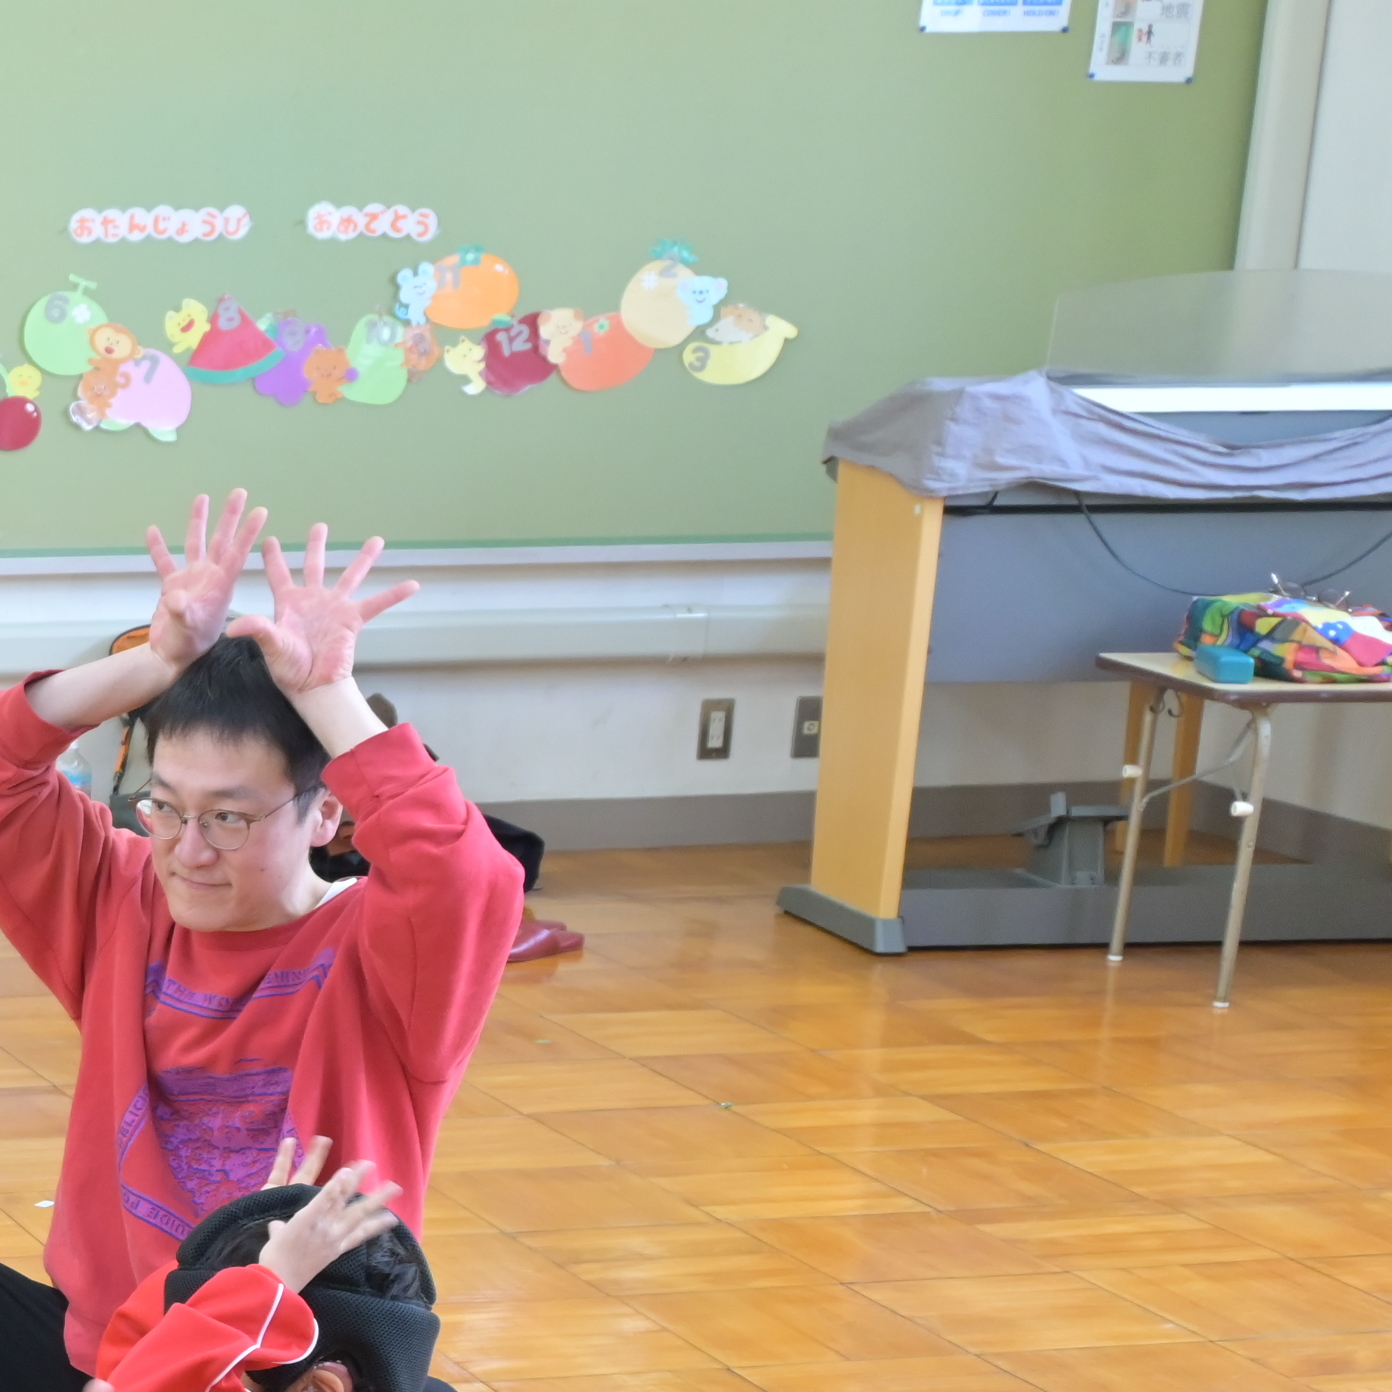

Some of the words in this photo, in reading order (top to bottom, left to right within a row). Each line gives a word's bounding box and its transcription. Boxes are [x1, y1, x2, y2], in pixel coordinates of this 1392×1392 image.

[73, 210, 250, 239] おたんじょうび
[312, 209, 432, 237] おめでとう
[436, 263, 461, 290] 11
[659, 252, 680, 279] 2
[44, 293, 71, 325] 6
[218, 299, 243, 331] 8
[367, 319, 398, 347] 10
[495, 322, 533, 357] 12
[579, 328, 594, 355] 1
[134, 352, 161, 384] 7
[688, 347, 713, 374] 3
